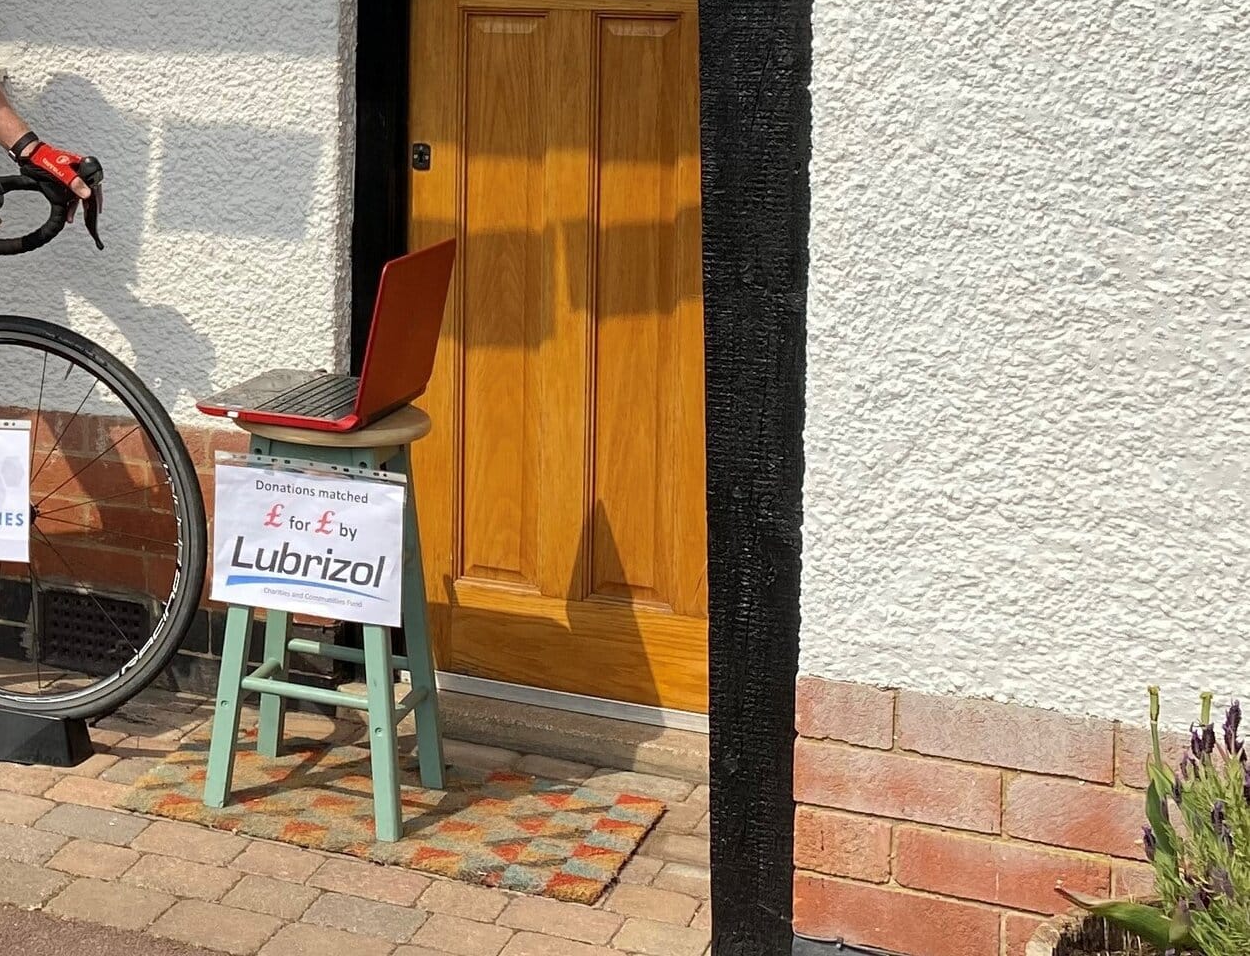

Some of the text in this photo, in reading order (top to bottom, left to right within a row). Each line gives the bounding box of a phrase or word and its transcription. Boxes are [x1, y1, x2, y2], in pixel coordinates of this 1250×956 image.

[255, 479, 369, 504] Donations matched
[264, 503, 358, 542] £ for £ by
[230, 535, 387, 589] Lubrizol
